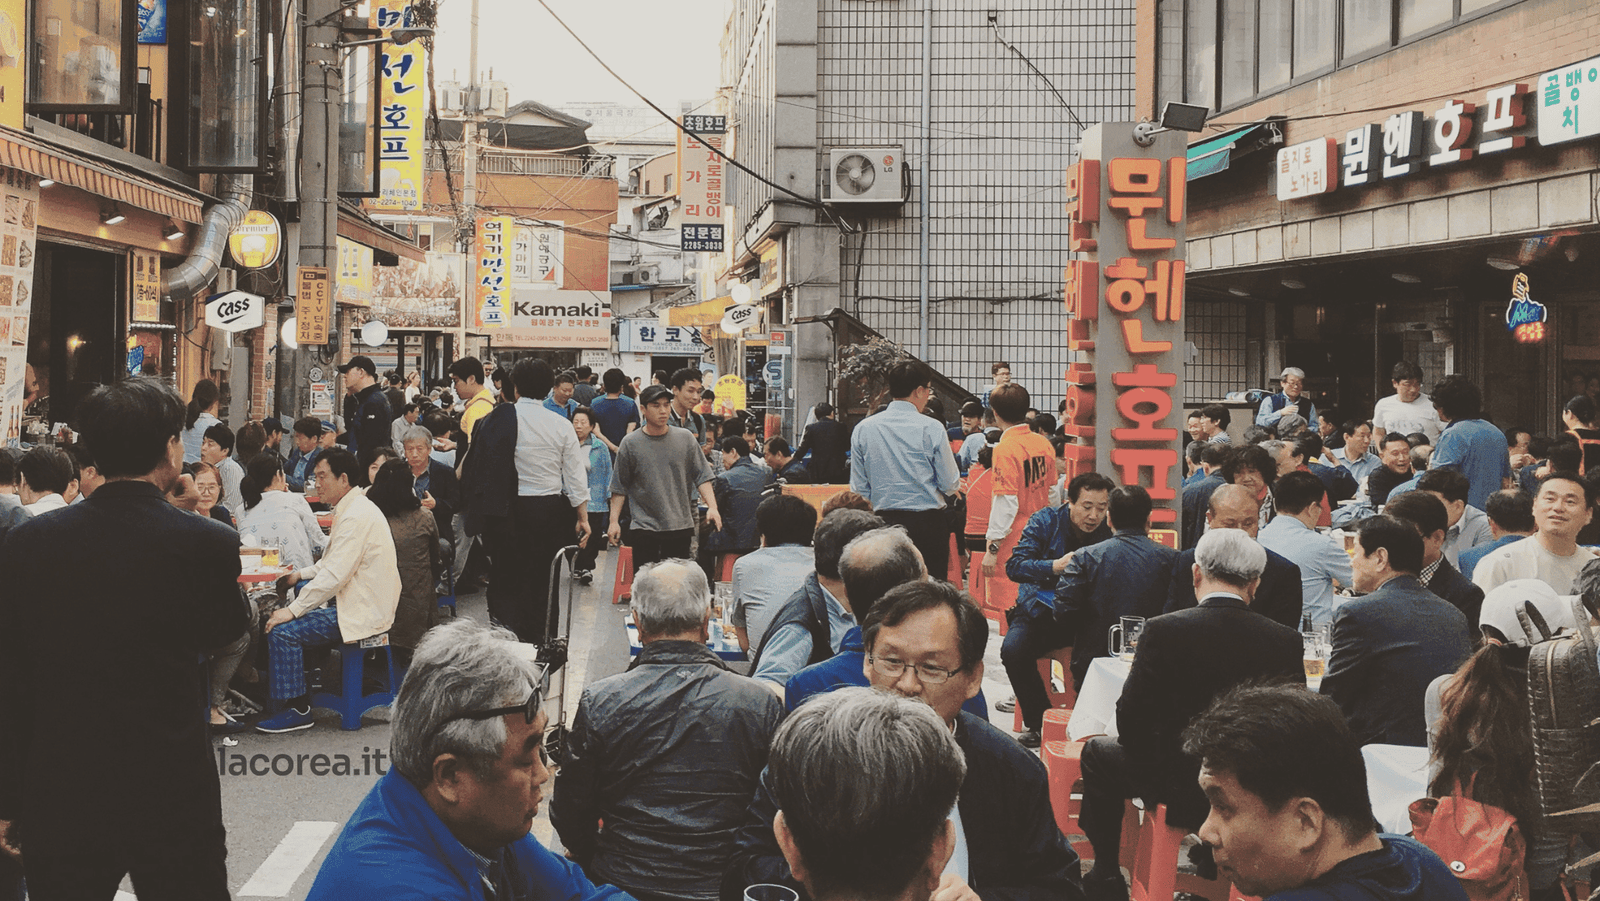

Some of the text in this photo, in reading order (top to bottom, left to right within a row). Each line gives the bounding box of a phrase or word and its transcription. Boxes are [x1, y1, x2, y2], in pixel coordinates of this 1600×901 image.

[685, 116, 724, 131] 초원호프
[1281, 146, 1312, 174] 을지로
[1290, 168, 1322, 193] 노가리
[684, 227, 722, 240] 전문점
[316, 282, 324, 312] CCTV
[514, 301, 599, 317] Kamaki
[1104, 157, 1187, 523] 뮌헨호프
